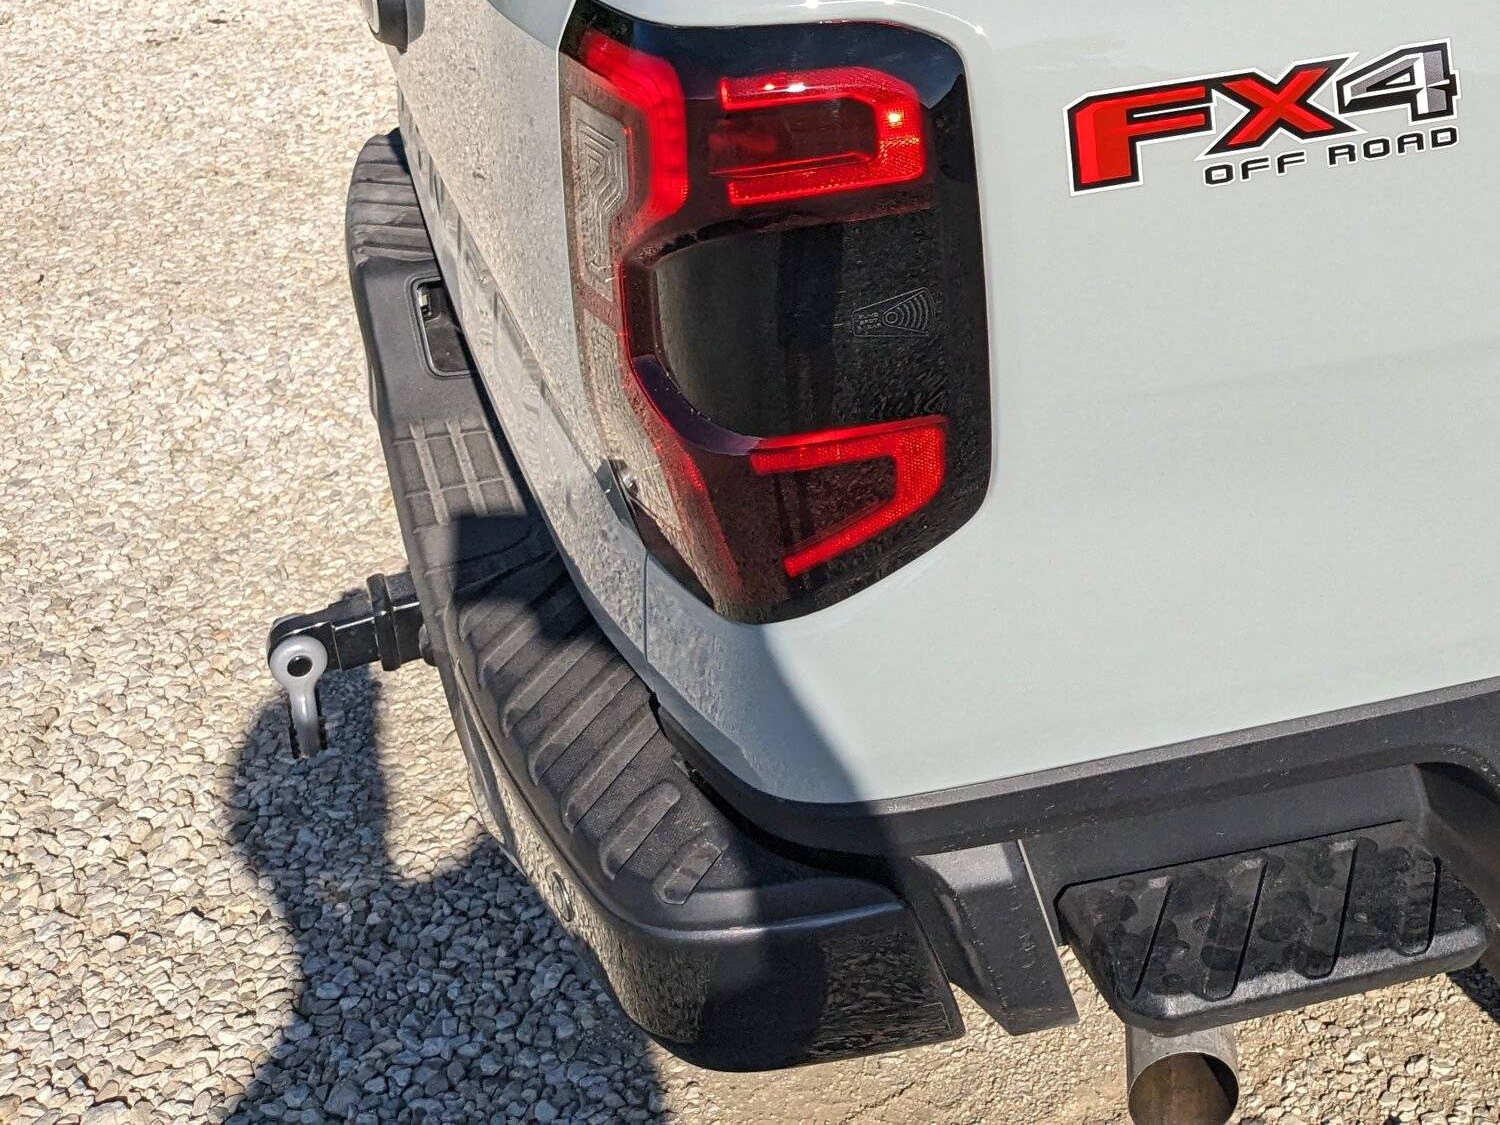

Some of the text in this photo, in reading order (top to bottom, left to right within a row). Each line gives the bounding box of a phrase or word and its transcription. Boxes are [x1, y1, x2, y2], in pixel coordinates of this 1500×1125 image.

[1063, 38, 1460, 195] FX4
[1205, 126, 1458, 186] OFF ROAD
